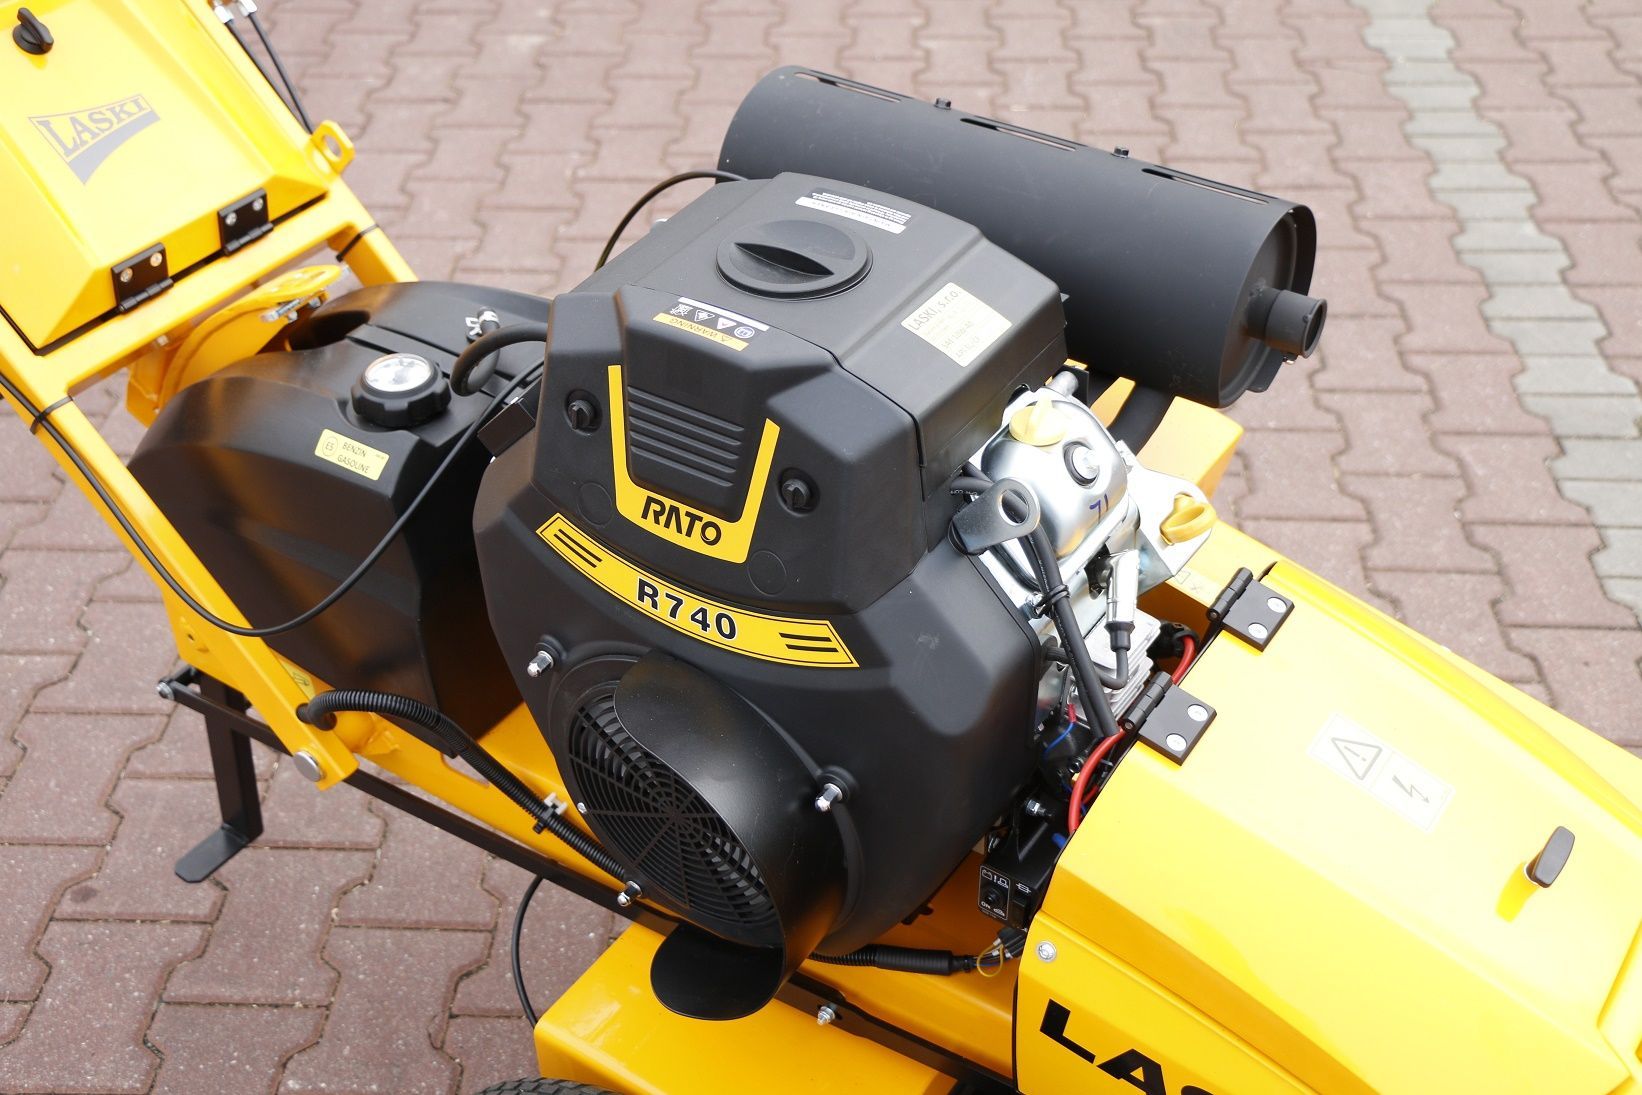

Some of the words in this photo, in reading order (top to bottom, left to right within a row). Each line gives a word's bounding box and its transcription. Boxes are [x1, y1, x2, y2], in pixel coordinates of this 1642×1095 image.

[35, 97, 147, 158] LASKI
[668, 317, 719, 338] WARNING
[337, 454, 370, 474] GASOLINE
[342, 441, 367, 457] BENZIN
[640, 494, 722, 547] RATO
[636, 576, 738, 641] R740
[1039, 998, 1216, 1095] LA
